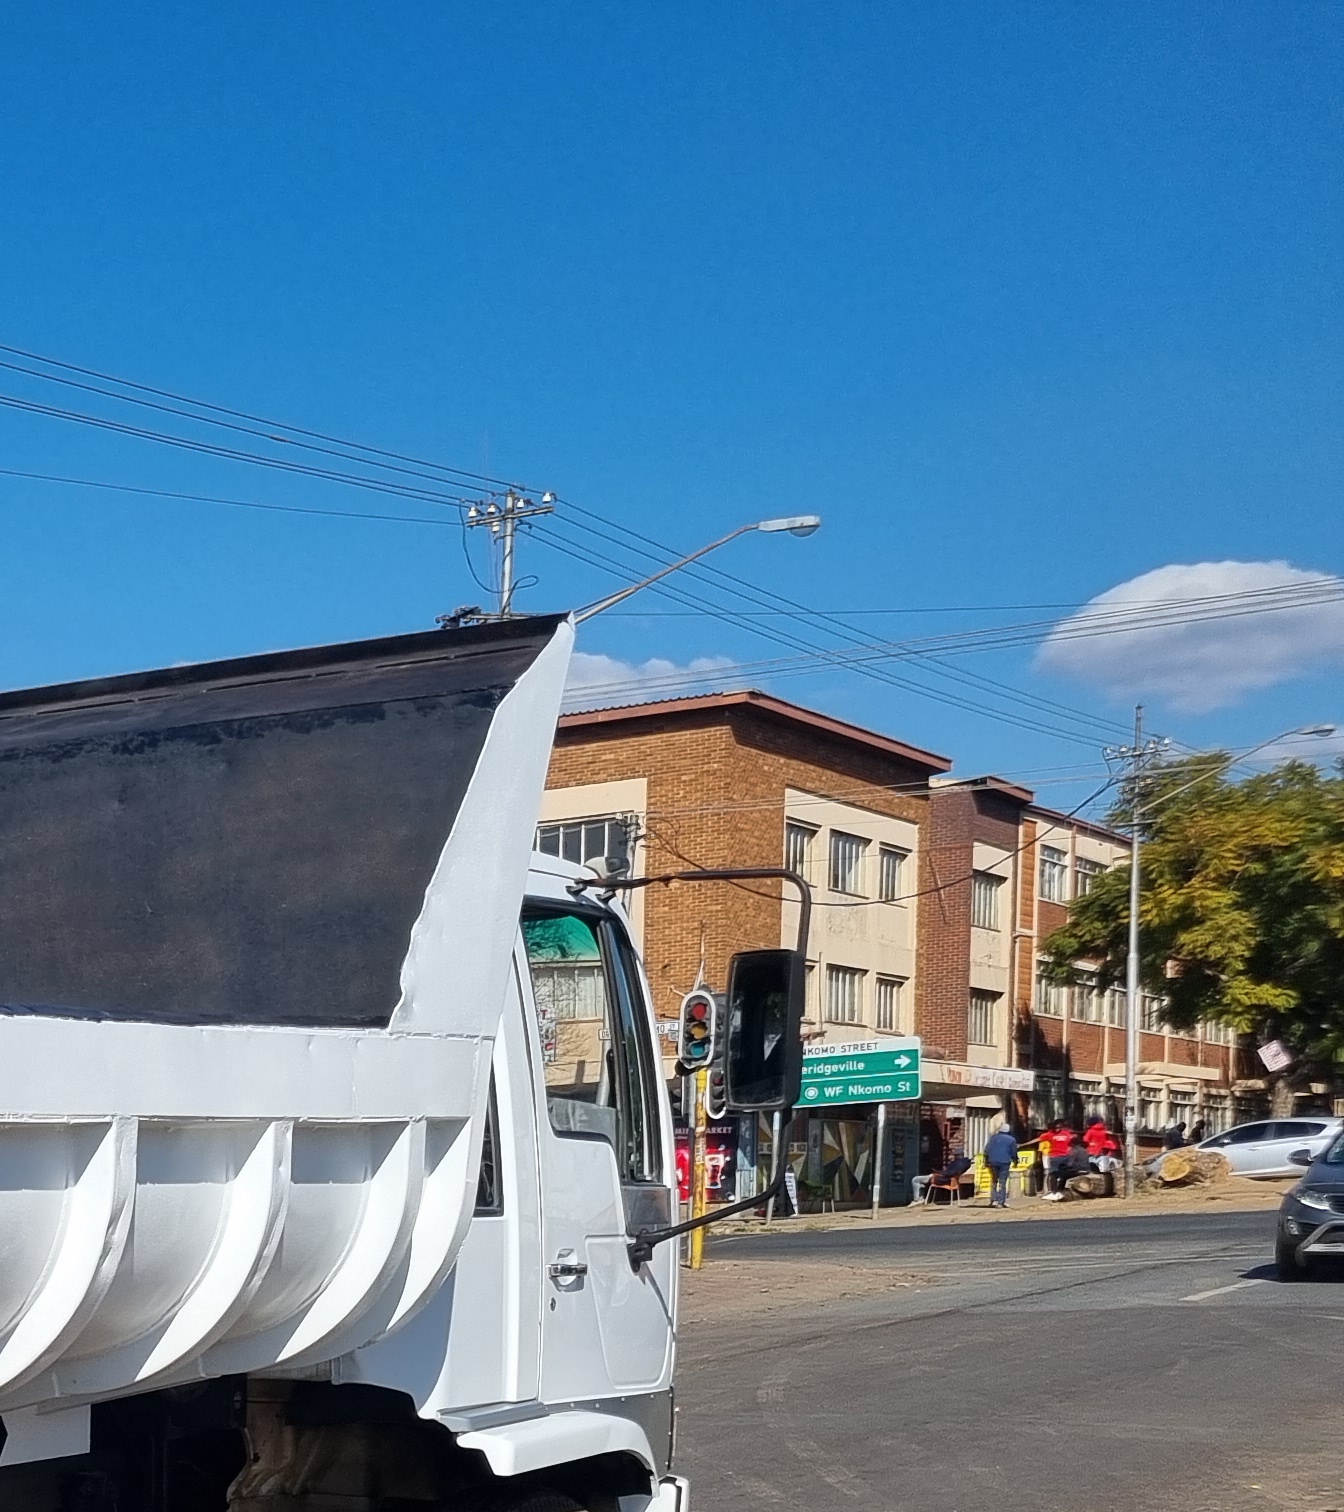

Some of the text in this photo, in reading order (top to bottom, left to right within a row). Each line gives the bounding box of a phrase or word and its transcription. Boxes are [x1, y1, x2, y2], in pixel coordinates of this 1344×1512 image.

[840, 1042, 879, 1053] STREET
[823, 1081, 911, 1098] WF Nkomo St
[705, 1126, 733, 1134] ARKET
